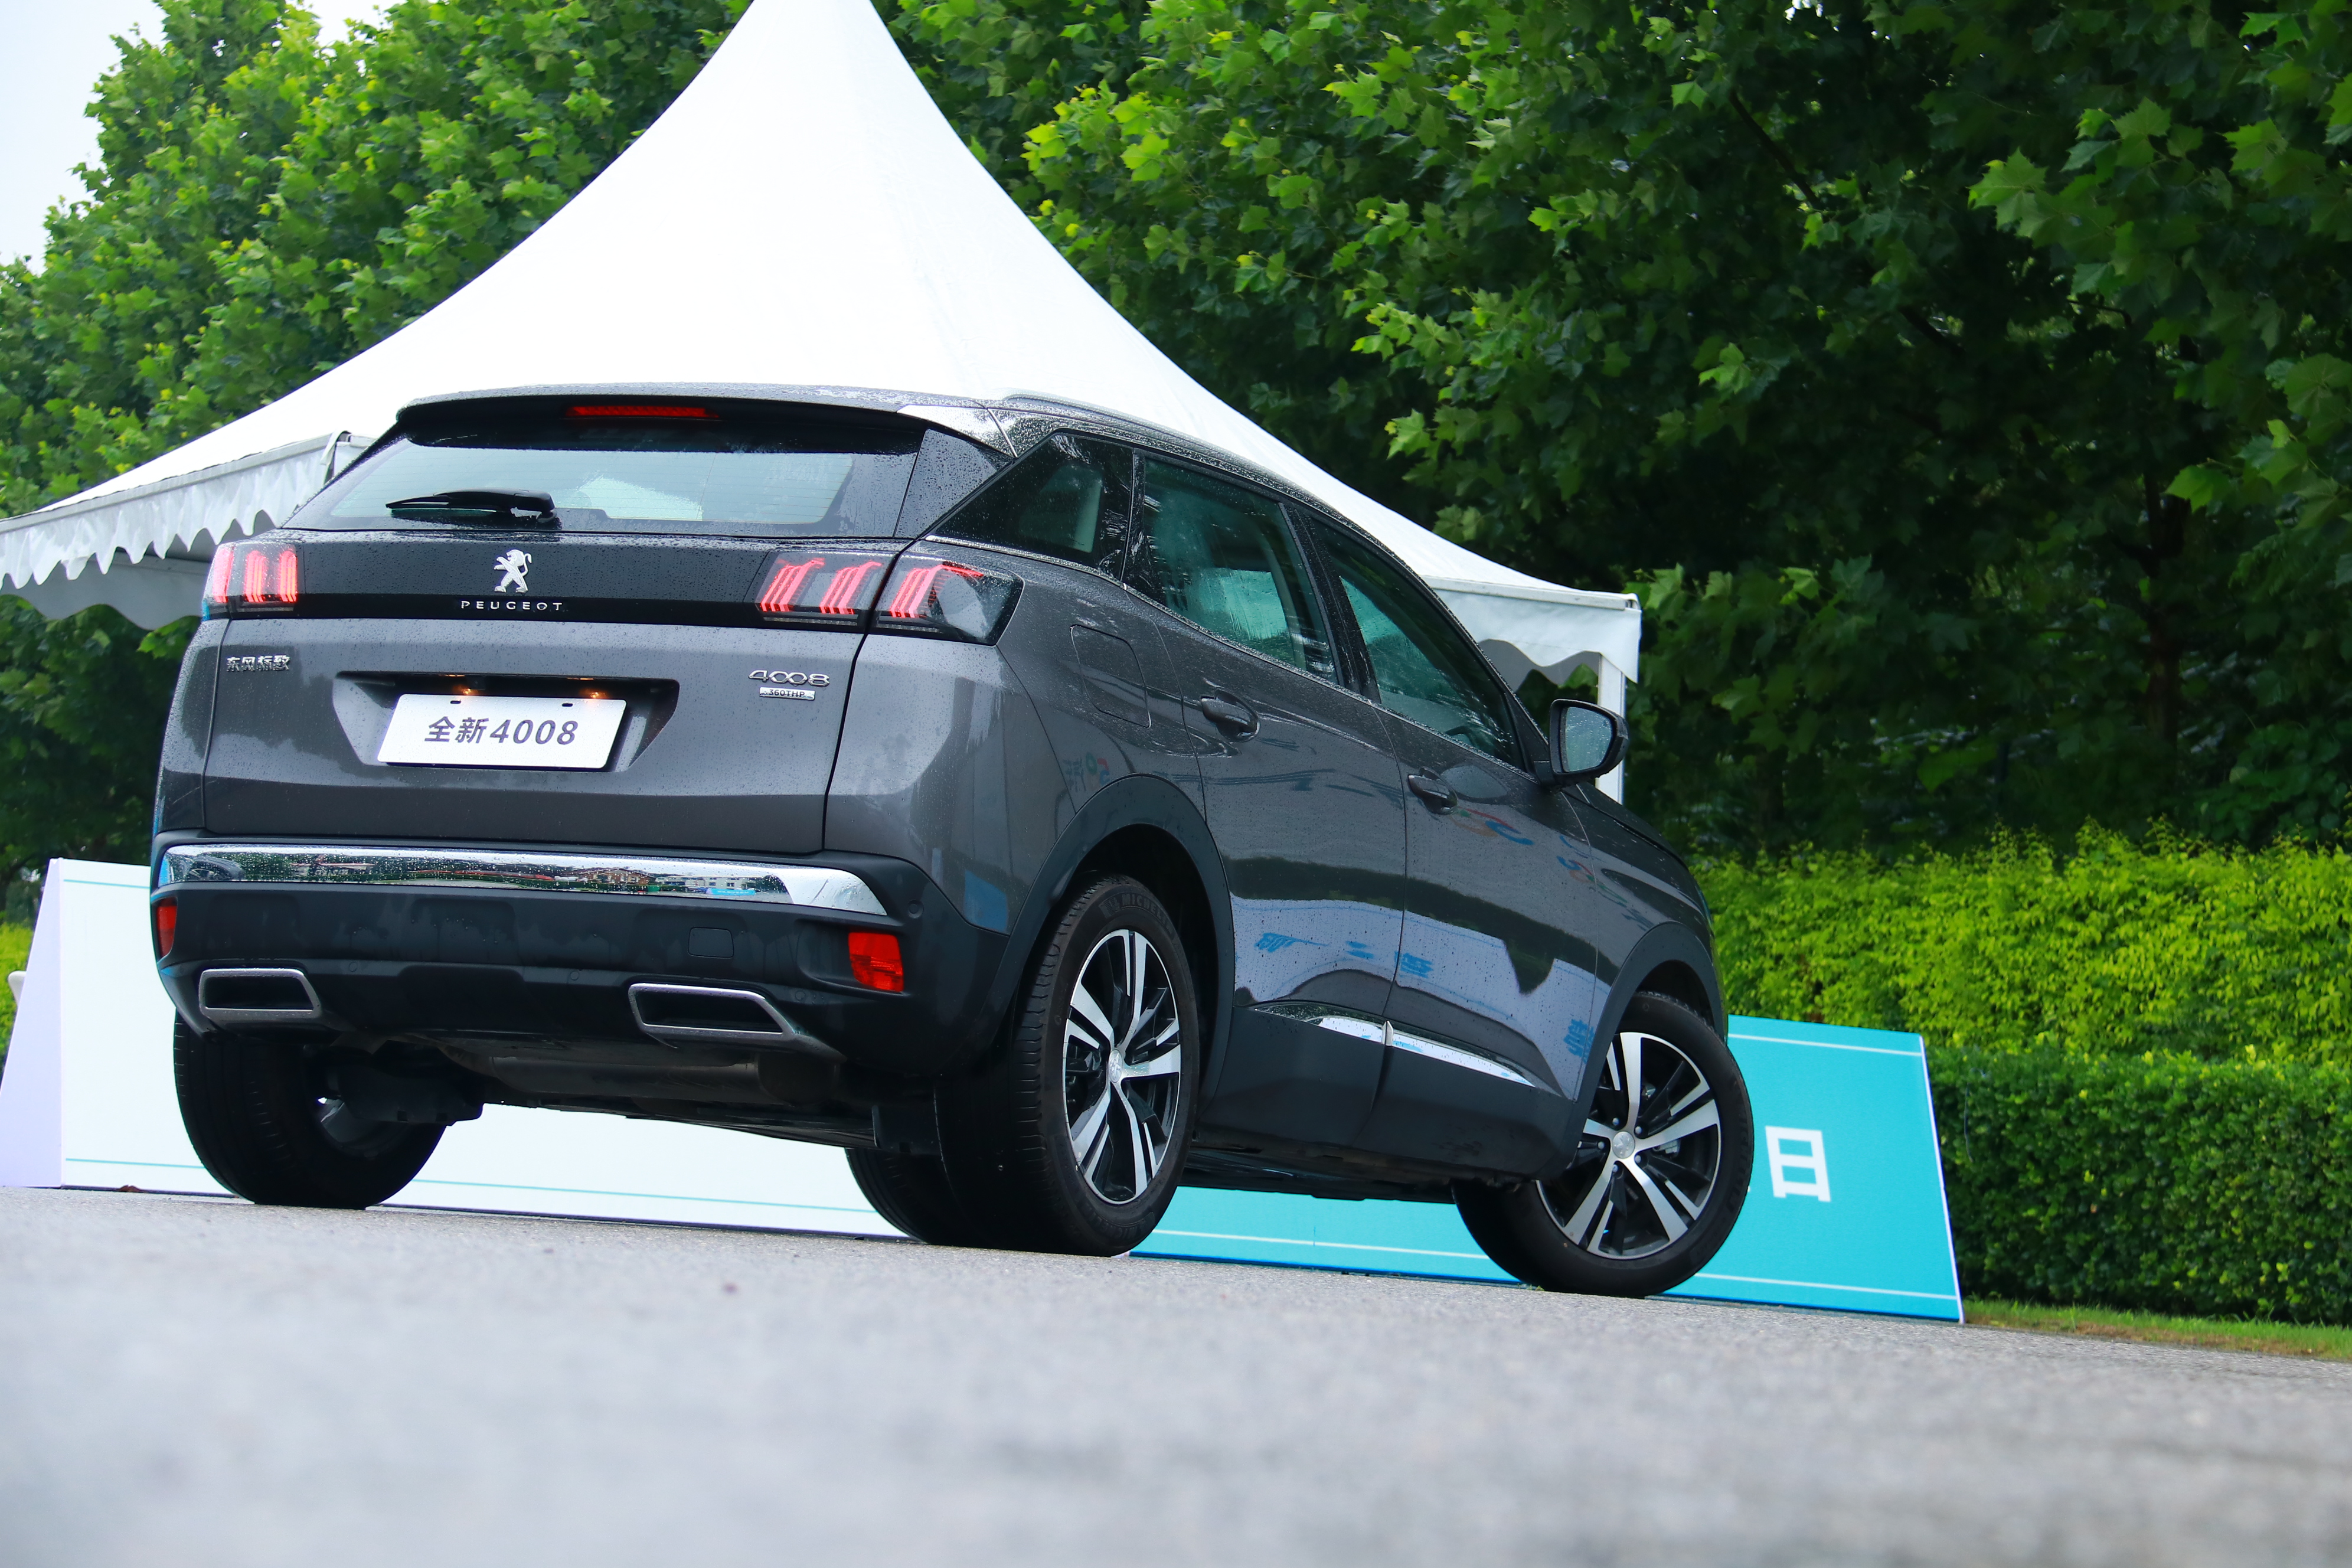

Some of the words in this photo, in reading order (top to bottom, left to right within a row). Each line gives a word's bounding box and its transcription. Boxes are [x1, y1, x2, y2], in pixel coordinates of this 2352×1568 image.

[460, 600, 563, 610] PEUGEOT
[227, 655, 290, 672] 东风标致
[748, 669, 830, 687] 4008
[769, 689, 806, 698] 360THP
[424, 716, 579, 746] 全新4008
